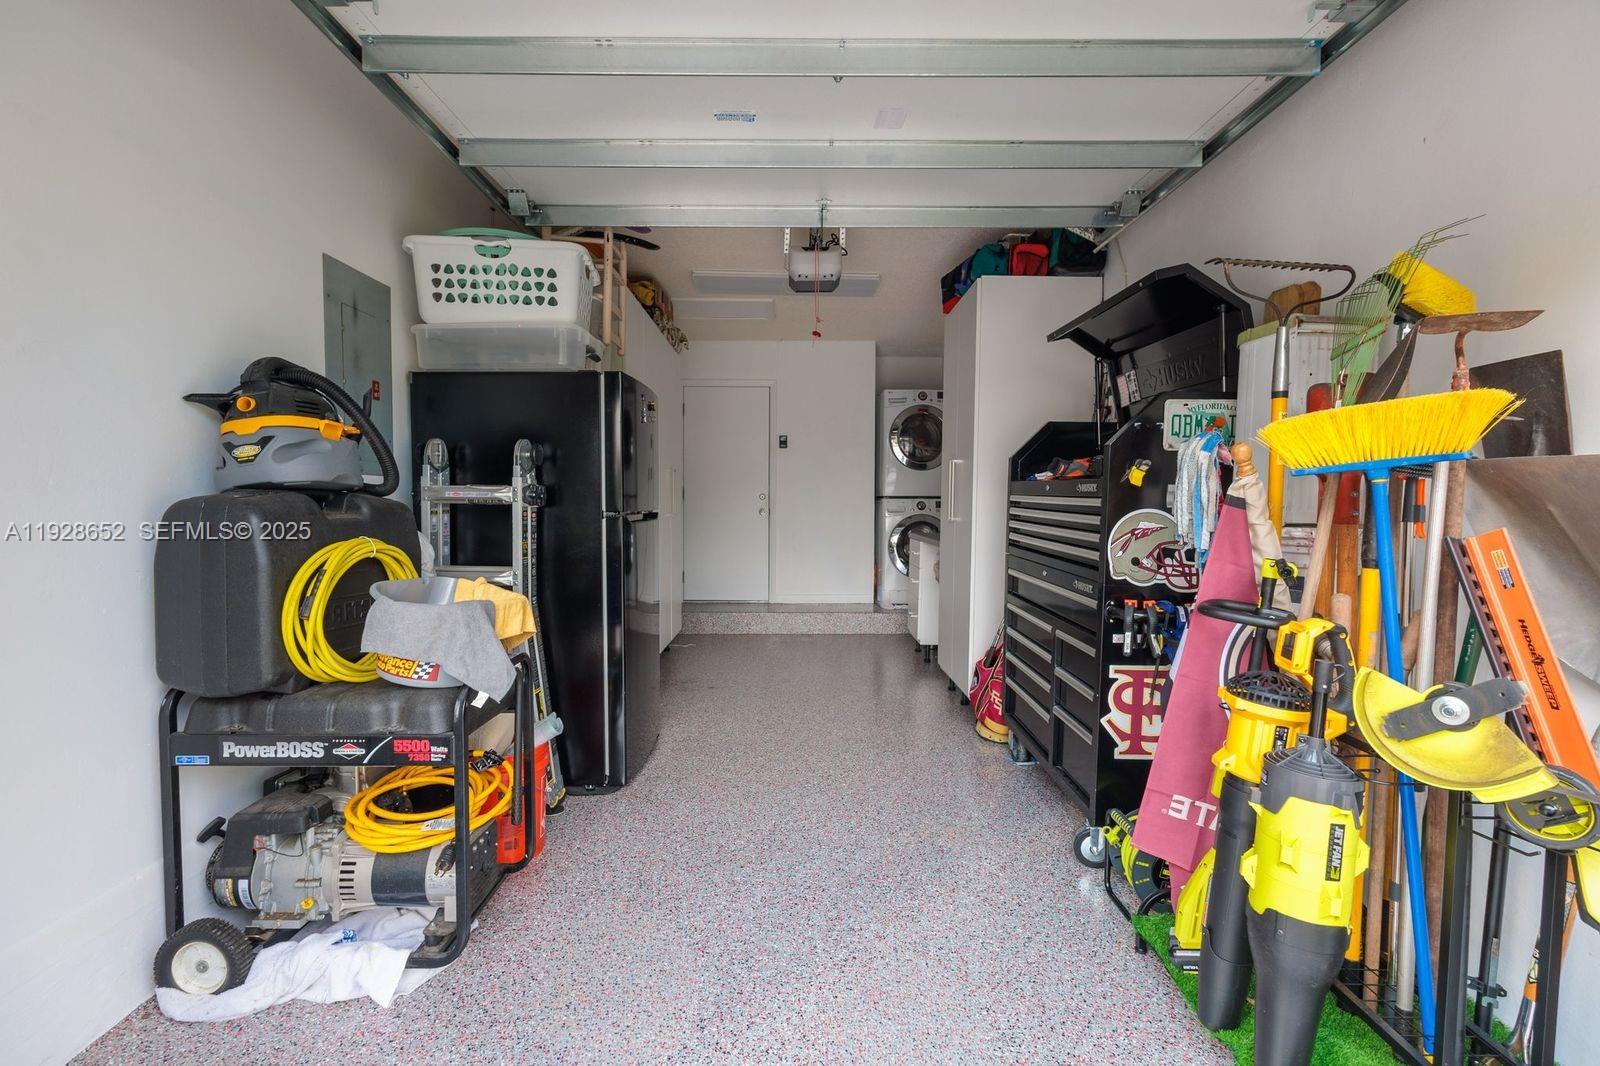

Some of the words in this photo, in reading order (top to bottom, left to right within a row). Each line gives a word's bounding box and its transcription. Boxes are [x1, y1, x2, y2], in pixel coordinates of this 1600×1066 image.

[222, 741, 325, 758] PowerBOSS
[393, 739, 430, 752] 5500
[1332, 845, 1342, 867] FAN
